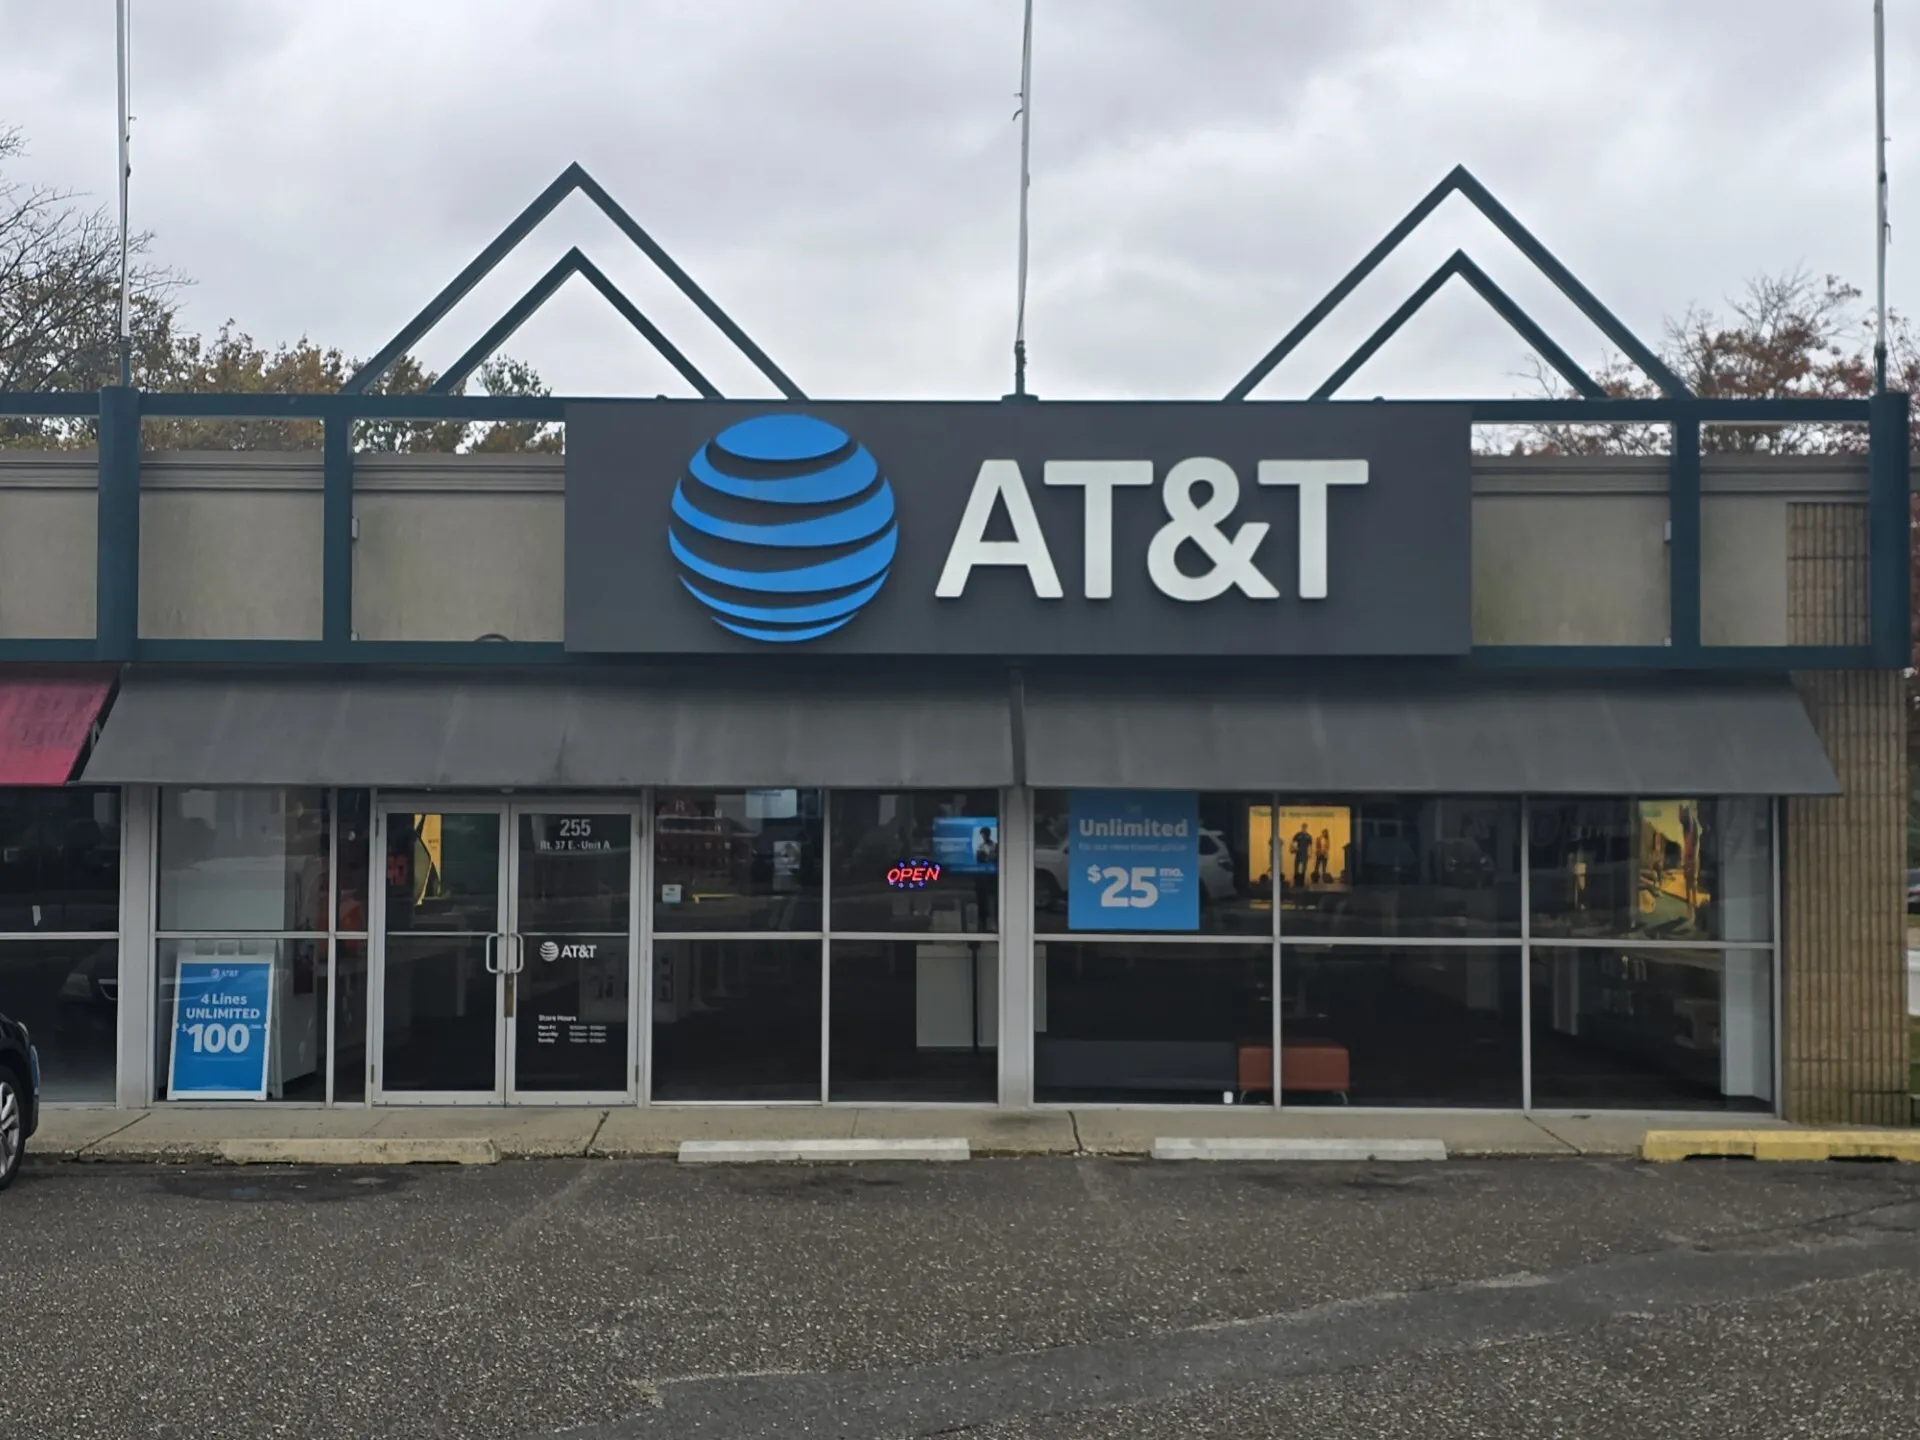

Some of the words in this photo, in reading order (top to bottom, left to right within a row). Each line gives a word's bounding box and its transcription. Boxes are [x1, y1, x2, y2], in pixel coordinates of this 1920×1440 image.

[935, 456, 1369, 602] AT&T
[559, 818, 592, 837] 255
[1079, 818, 1189, 837] Unlimited
[555, 839, 566, 850] 37
[581, 839, 601, 850] Unit
[603, 839, 612, 850] A
[887, 867, 941, 883] OPEN
[1087, 864, 1159, 908] $25
[560, 944, 598, 959] AT&T
[200, 993, 209, 1005] 4
[212, 992, 248, 1005] Lines
[186, 1007, 260, 1019] UNLIMITED
[182, 1023, 250, 1053] $100
